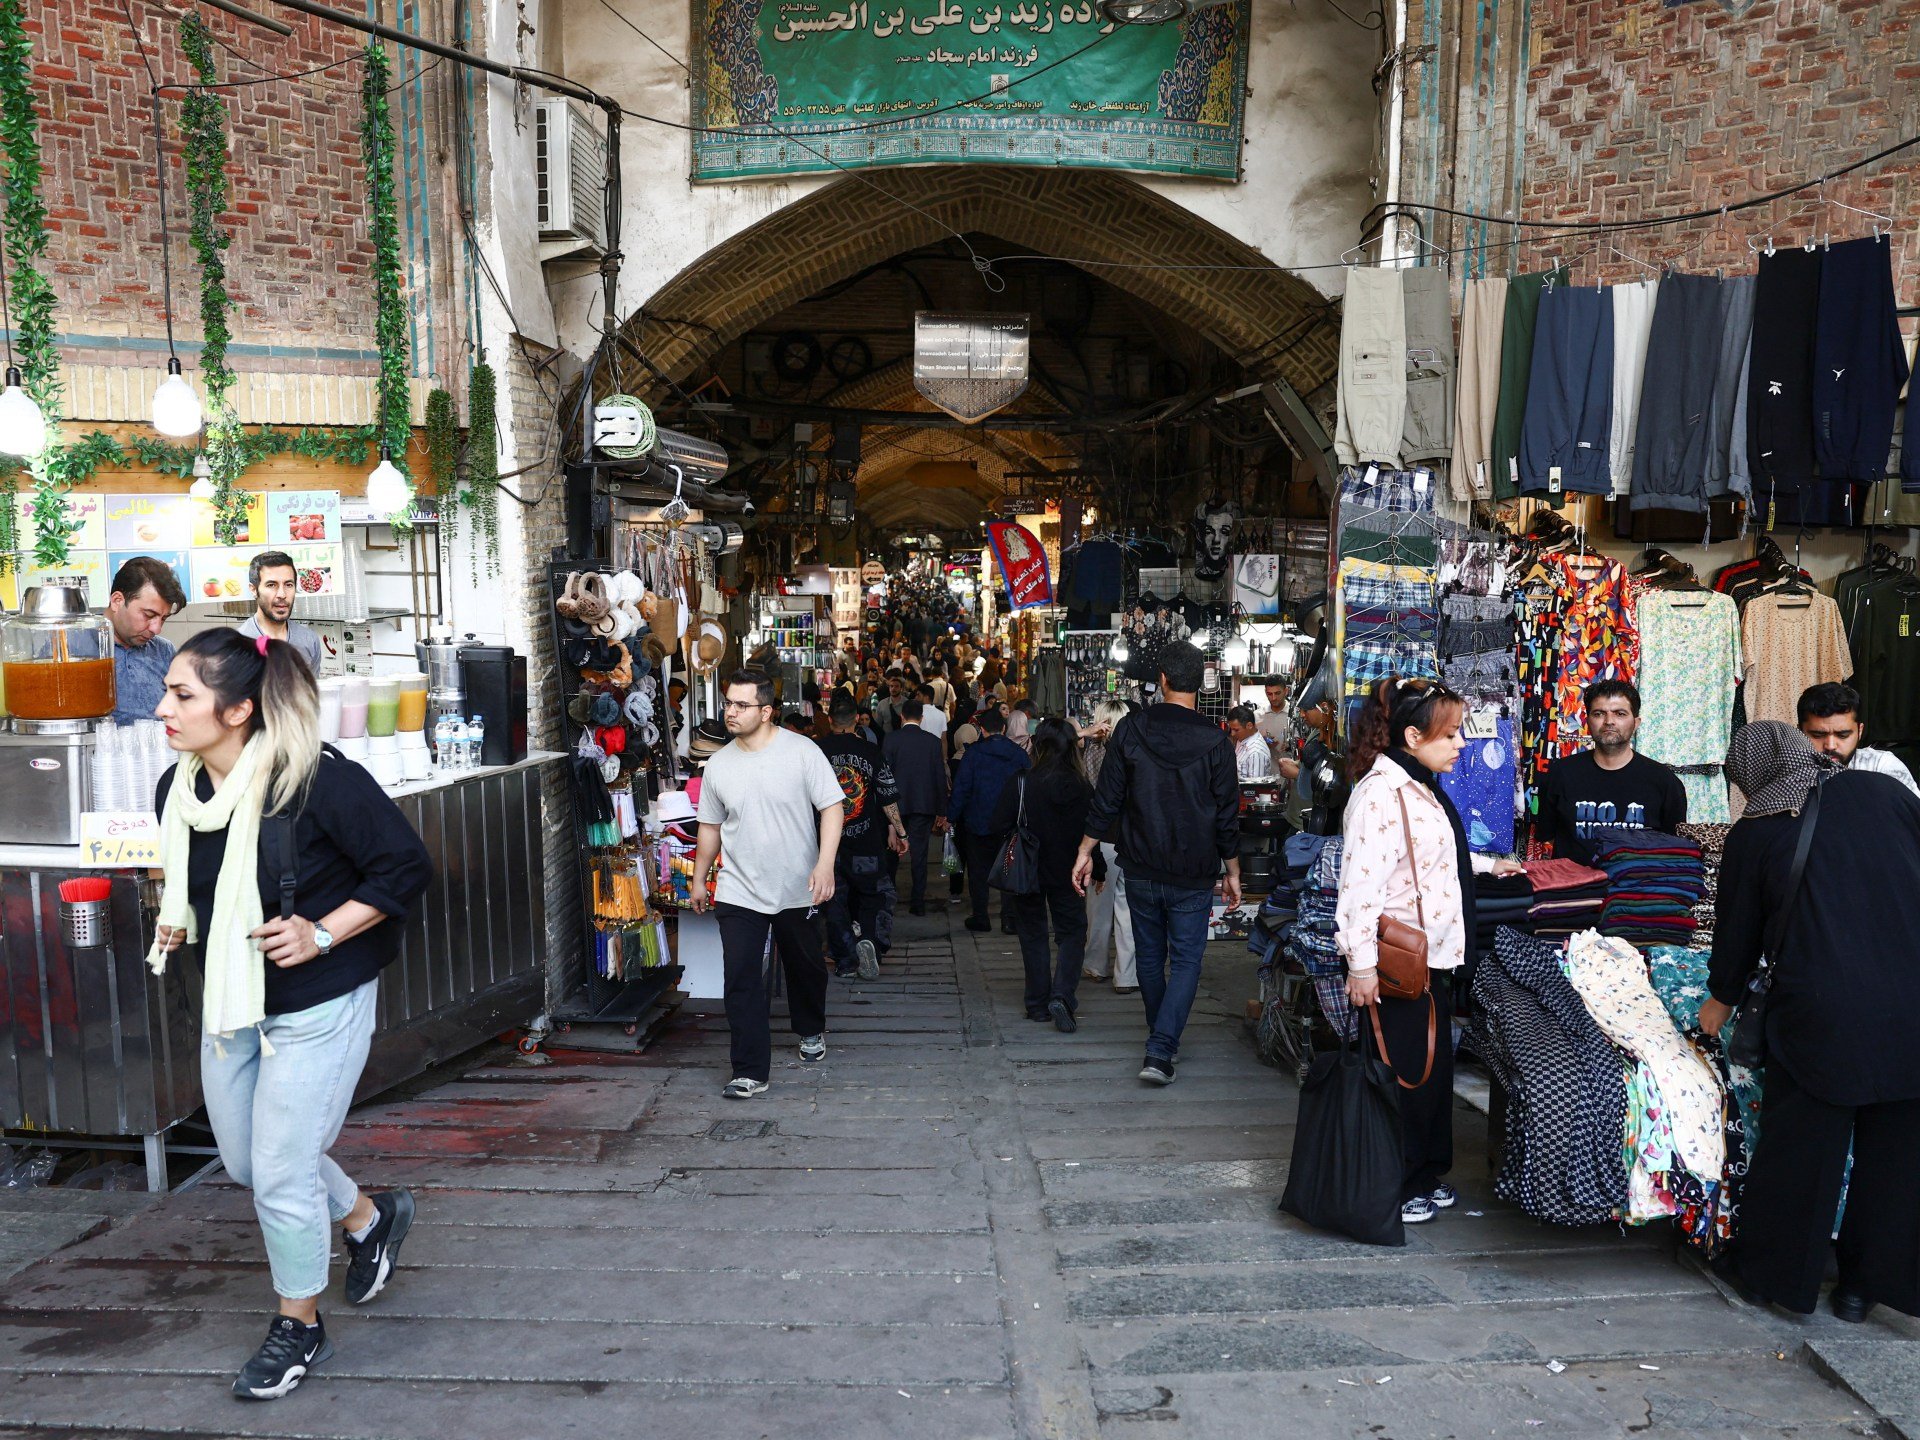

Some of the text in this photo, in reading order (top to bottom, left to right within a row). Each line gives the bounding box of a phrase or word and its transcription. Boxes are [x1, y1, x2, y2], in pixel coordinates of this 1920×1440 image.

[773, 0, 869, 42] الحسین
[872, 5, 906, 38] بن
[909, 0, 965, 35] علی
[968, 4, 1002, 34] بن
[1009, 0, 1054, 34] زید
[927, 44, 1039, 68] فرزند امام سجاد
[830, 104, 847, 116] تلفن
[875, 102, 891, 115] بازار
[1069, 100, 1151, 114] آرامگاه لطفعلی خان زند
[276, 493, 313, 514] فرنگی
[107, 819, 149, 836] هویج
